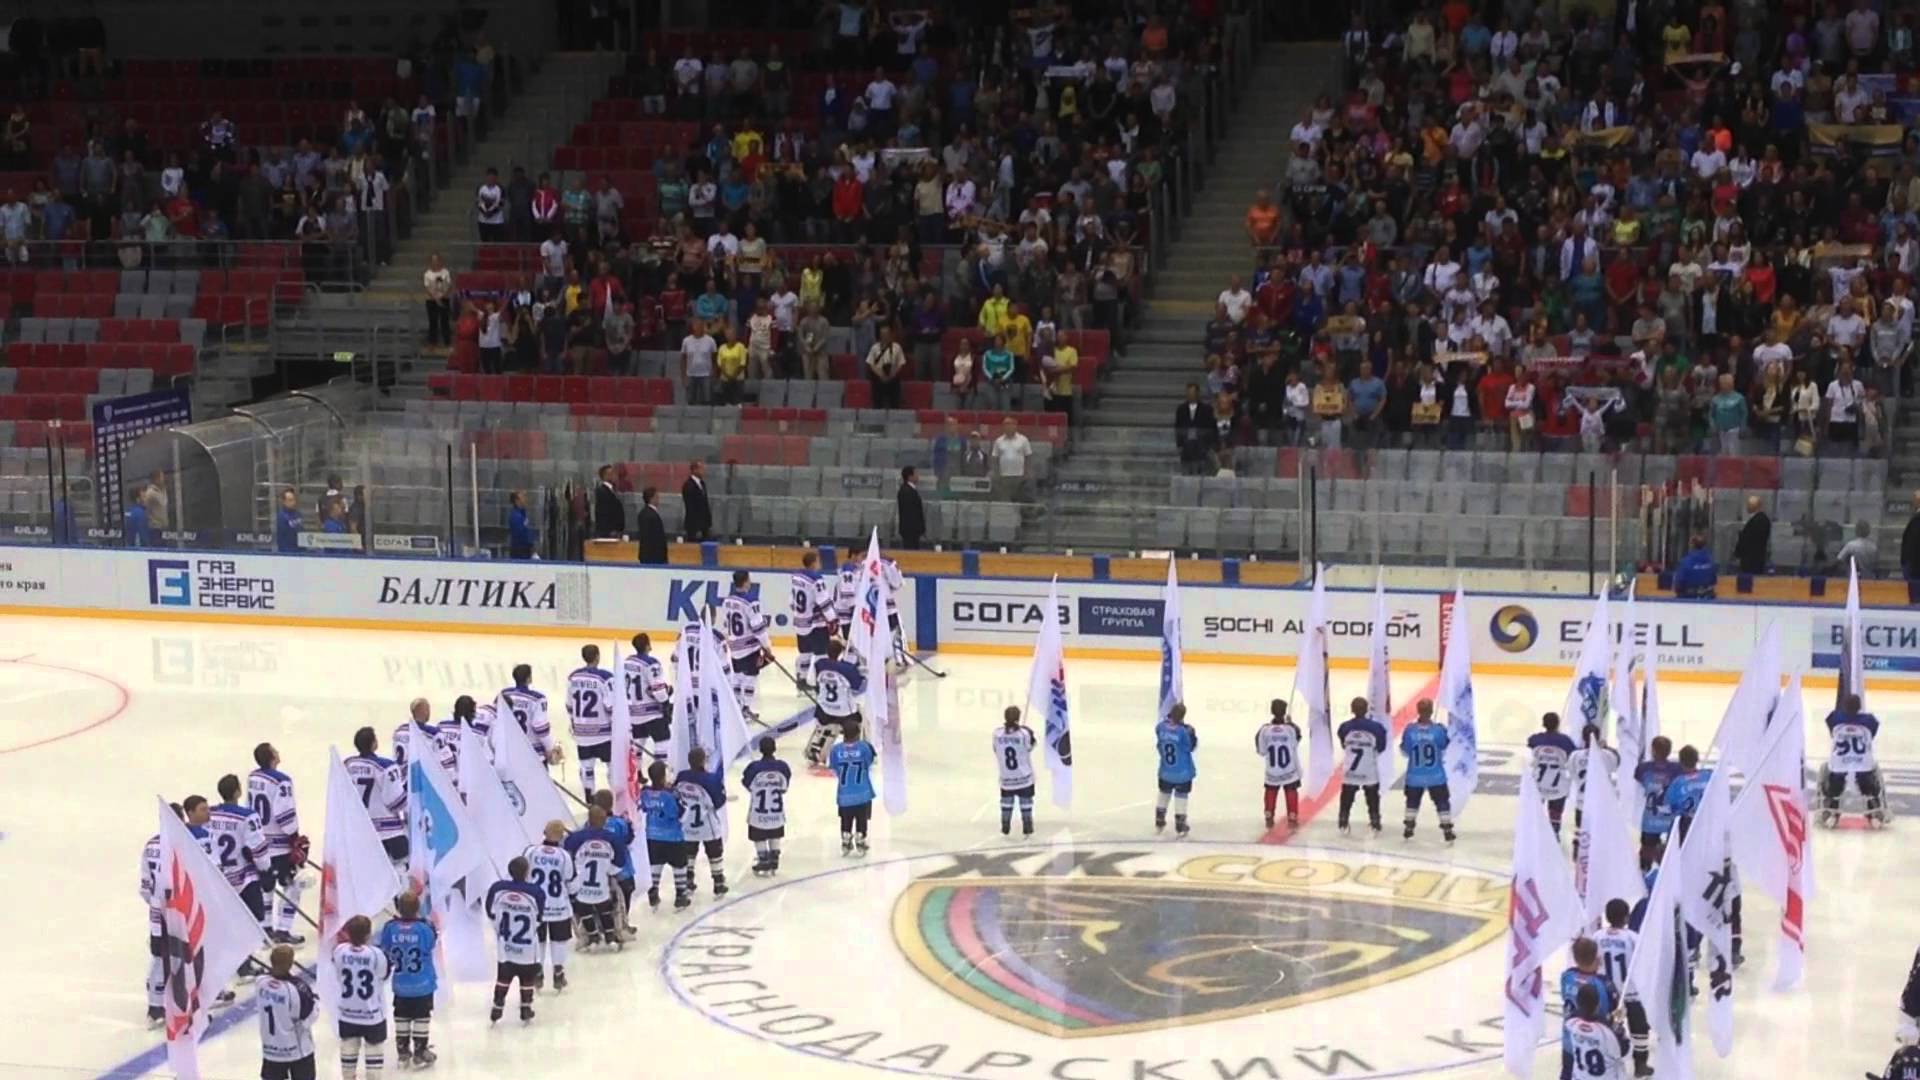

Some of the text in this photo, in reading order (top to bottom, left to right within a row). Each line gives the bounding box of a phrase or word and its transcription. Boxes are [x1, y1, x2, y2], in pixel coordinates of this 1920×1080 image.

[236, 532, 272, 543] KHL.RU
[198, 561, 236, 574] ГАЗ
[16, 581, 46, 593] края
[199, 576, 274, 593] ЭНЕРГО
[378, 576, 557, 609] БАЛТИКА
[200, 594, 275, 610] СЕРВИС
[953, 602, 1070, 625] СОГАЗ
[1091, 606, 1156, 617] СТРАХОВАЯ
[725, 611, 745, 637] 16
[1101, 618, 1144, 628] ГРУППА
[1204, 617, 1273, 637] SOCHI
[1560, 620, 1704, 647] EIELL
[1831, 624, 1917, 648] ВСТИ
[572, 690, 599, 718] 12
[825, 683, 839, 702] 8
[1004, 746, 1019, 770] 8
[1164, 743, 1177, 765] 8
[1267, 744, 1291, 769] 10
[1349, 747, 1365, 771] 7
[1413, 744, 1436, 767] 19
[838, 761, 863, 785] 77
[755, 789, 783, 815] 13
[689, 803, 705, 829] 1
[531, 868, 563, 899] 28
[582, 859, 601, 888] 1
[499, 911, 532, 945] 42
[391, 946, 422, 974] 33
[1604, 951, 1629, 984] 11
[341, 968, 375, 1001] 33
[263, 1005, 277, 1036] 1
